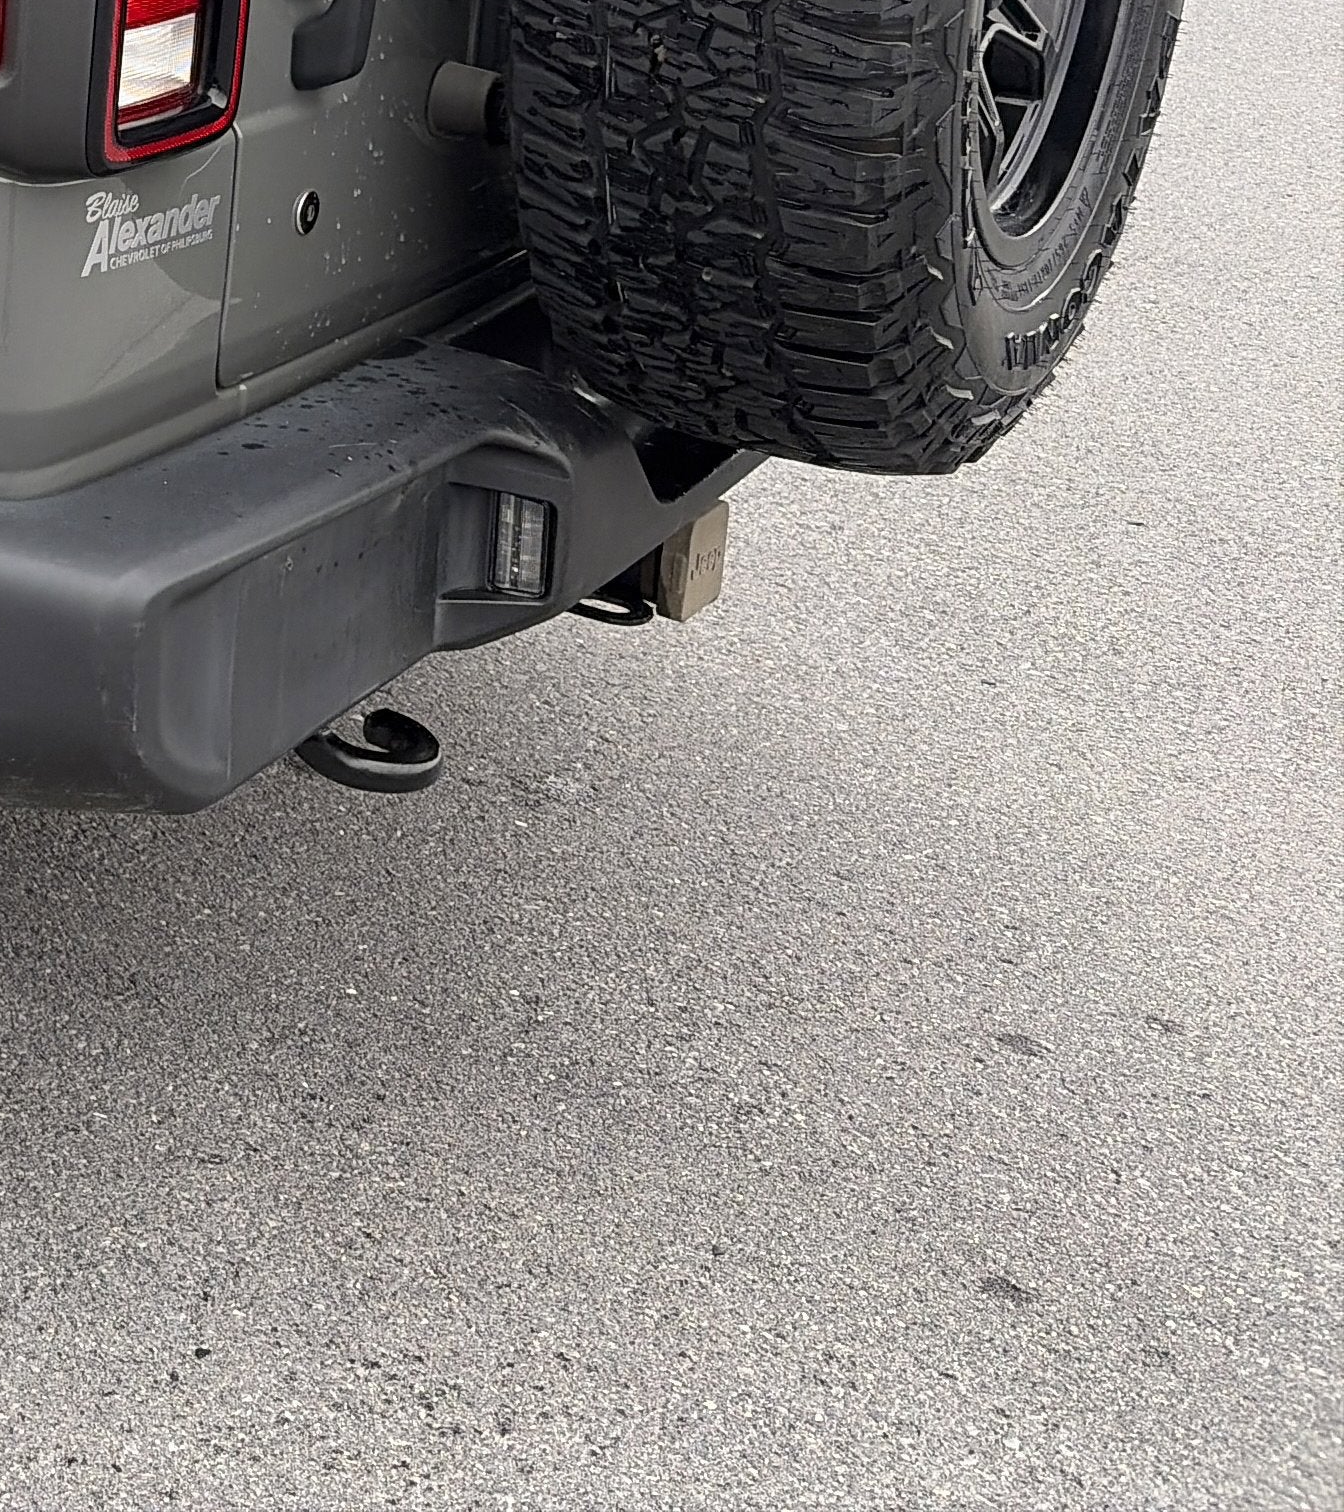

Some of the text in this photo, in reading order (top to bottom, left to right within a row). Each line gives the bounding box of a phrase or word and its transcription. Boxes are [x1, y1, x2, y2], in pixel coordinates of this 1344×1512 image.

[86, 191, 140, 223] Blaise
[81, 194, 221, 277] Alexander
[110, 245, 160, 269] CHEVROLET
[160, 243, 170, 255] OF
[691, 548, 721, 581] Jeep
